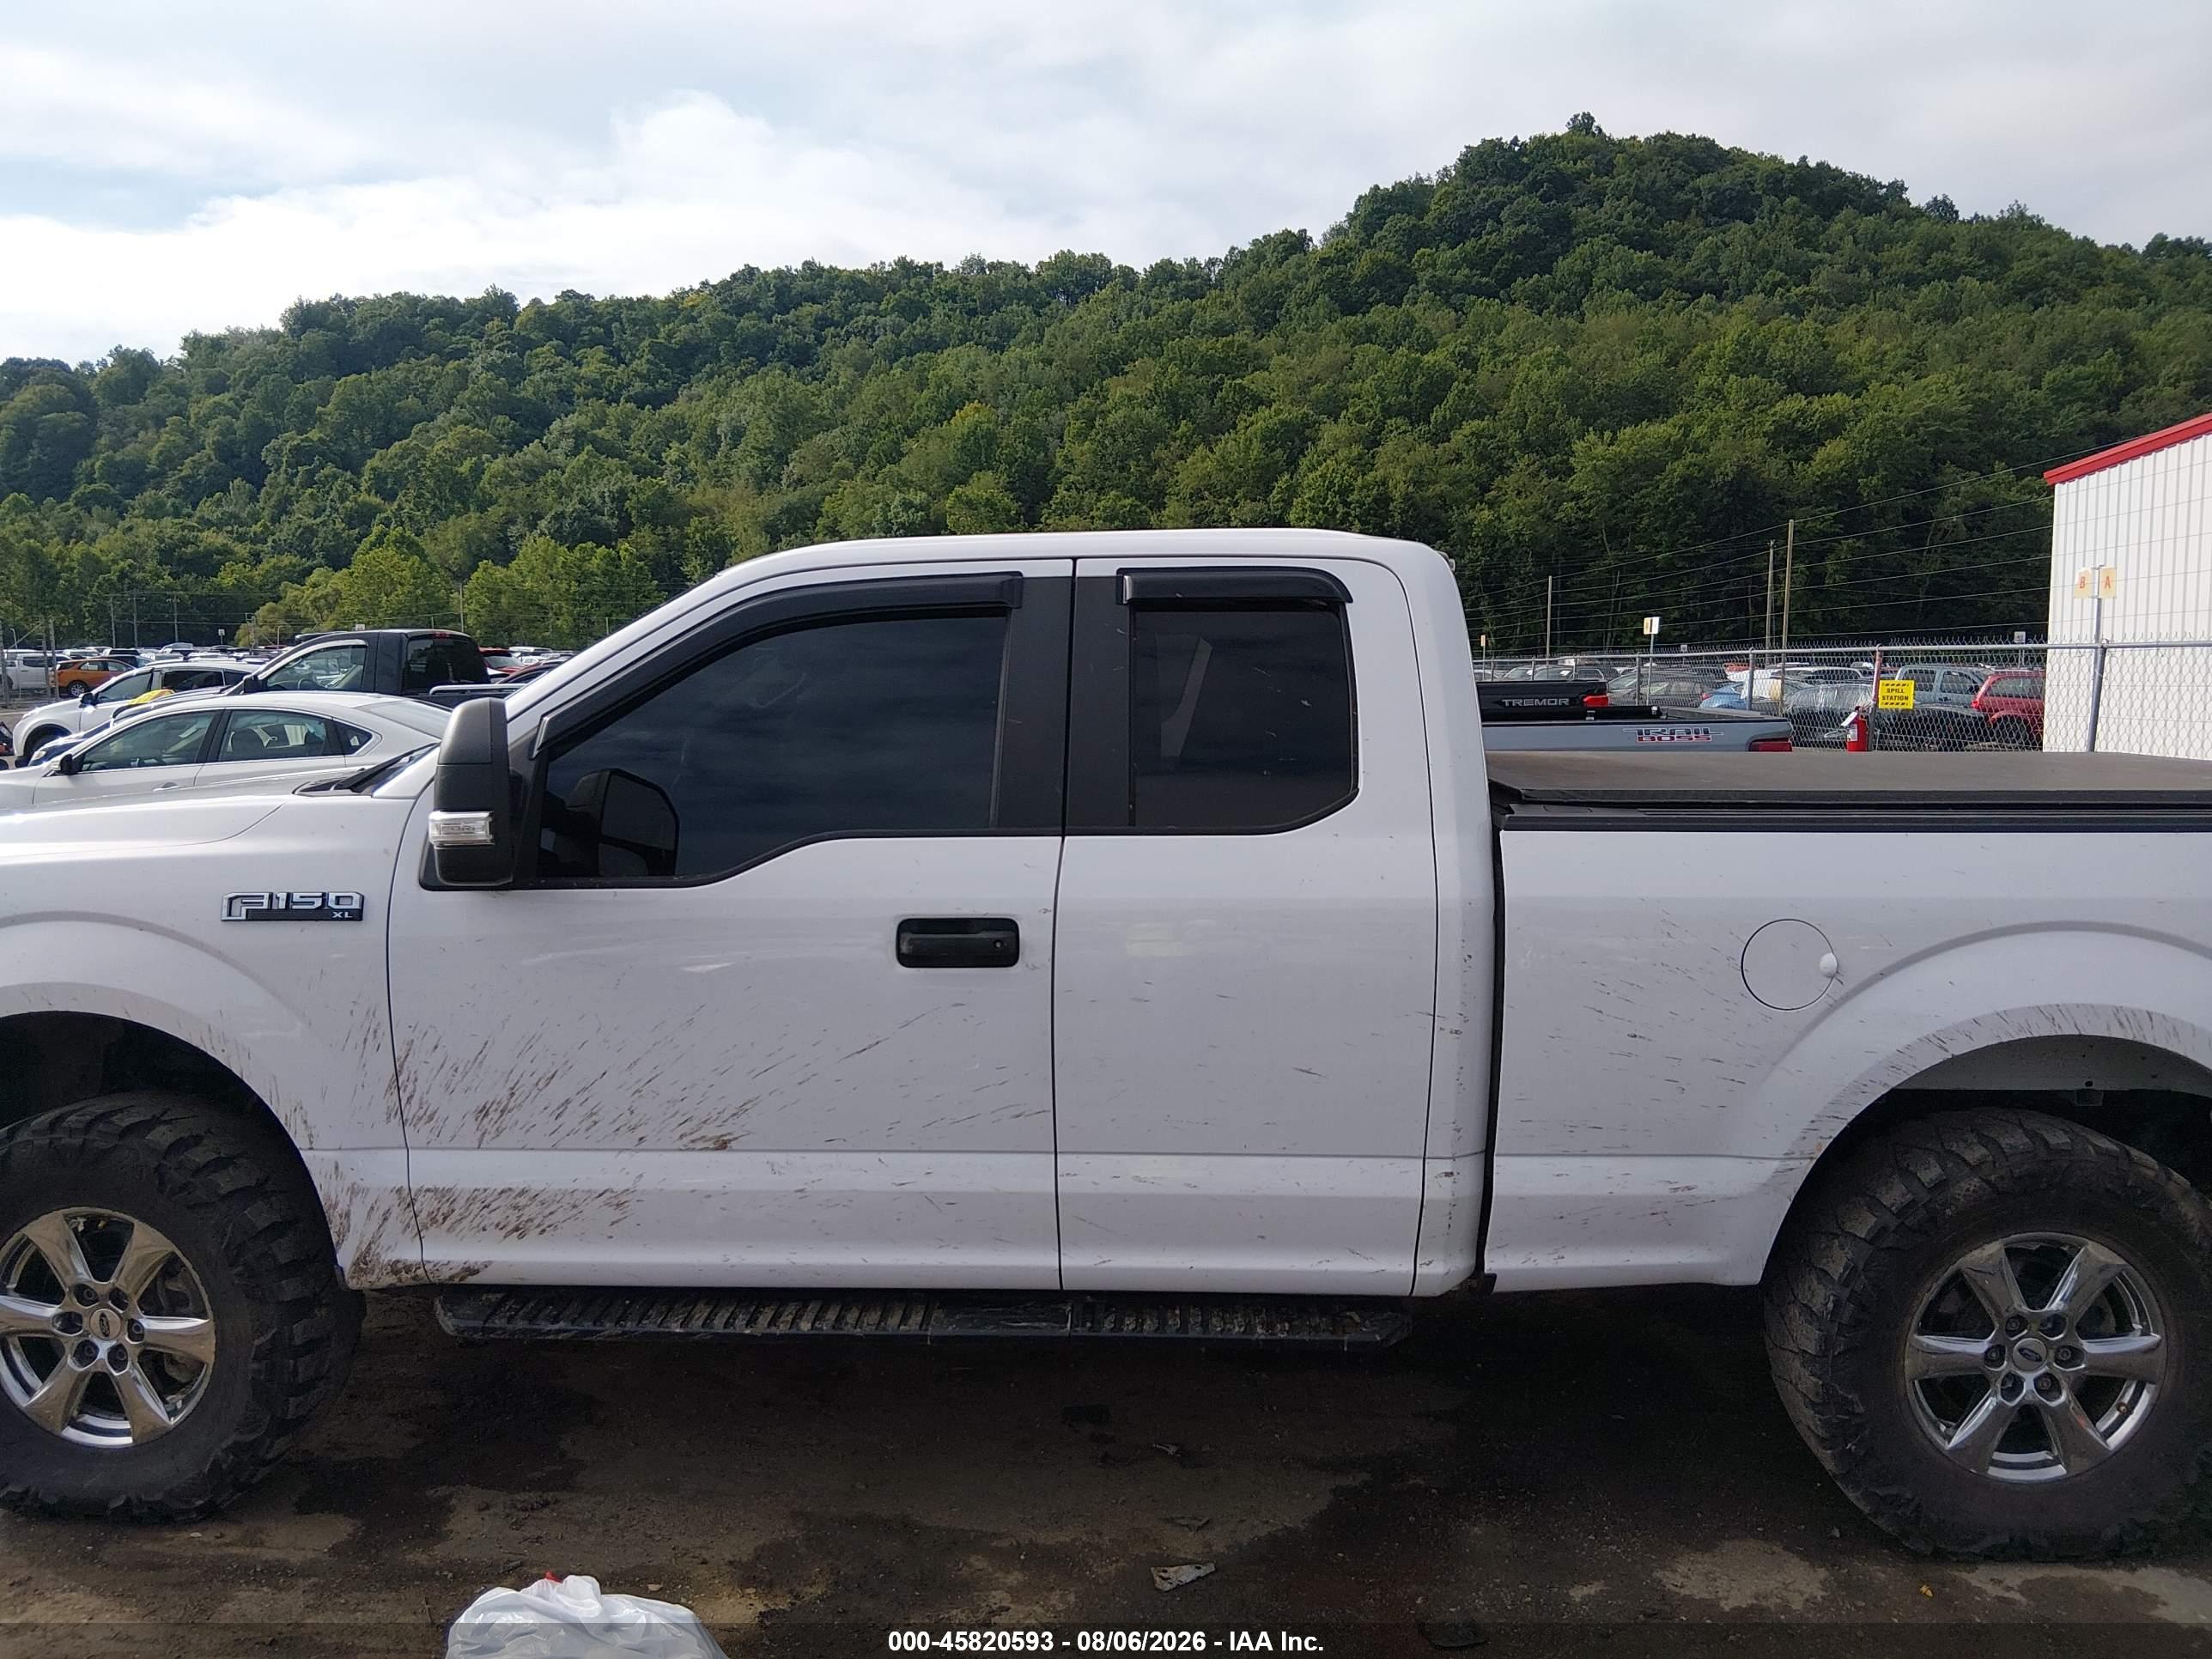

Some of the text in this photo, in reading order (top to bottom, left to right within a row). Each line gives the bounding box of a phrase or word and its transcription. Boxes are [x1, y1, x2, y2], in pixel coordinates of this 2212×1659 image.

[2079, 576, 2086, 589] B
[2104, 575, 2112, 589] A
[1501, 698, 1570, 707] TREMOR
[1622, 726, 1724, 736] TRAIL
[1637, 734, 1712, 743] BOSS
